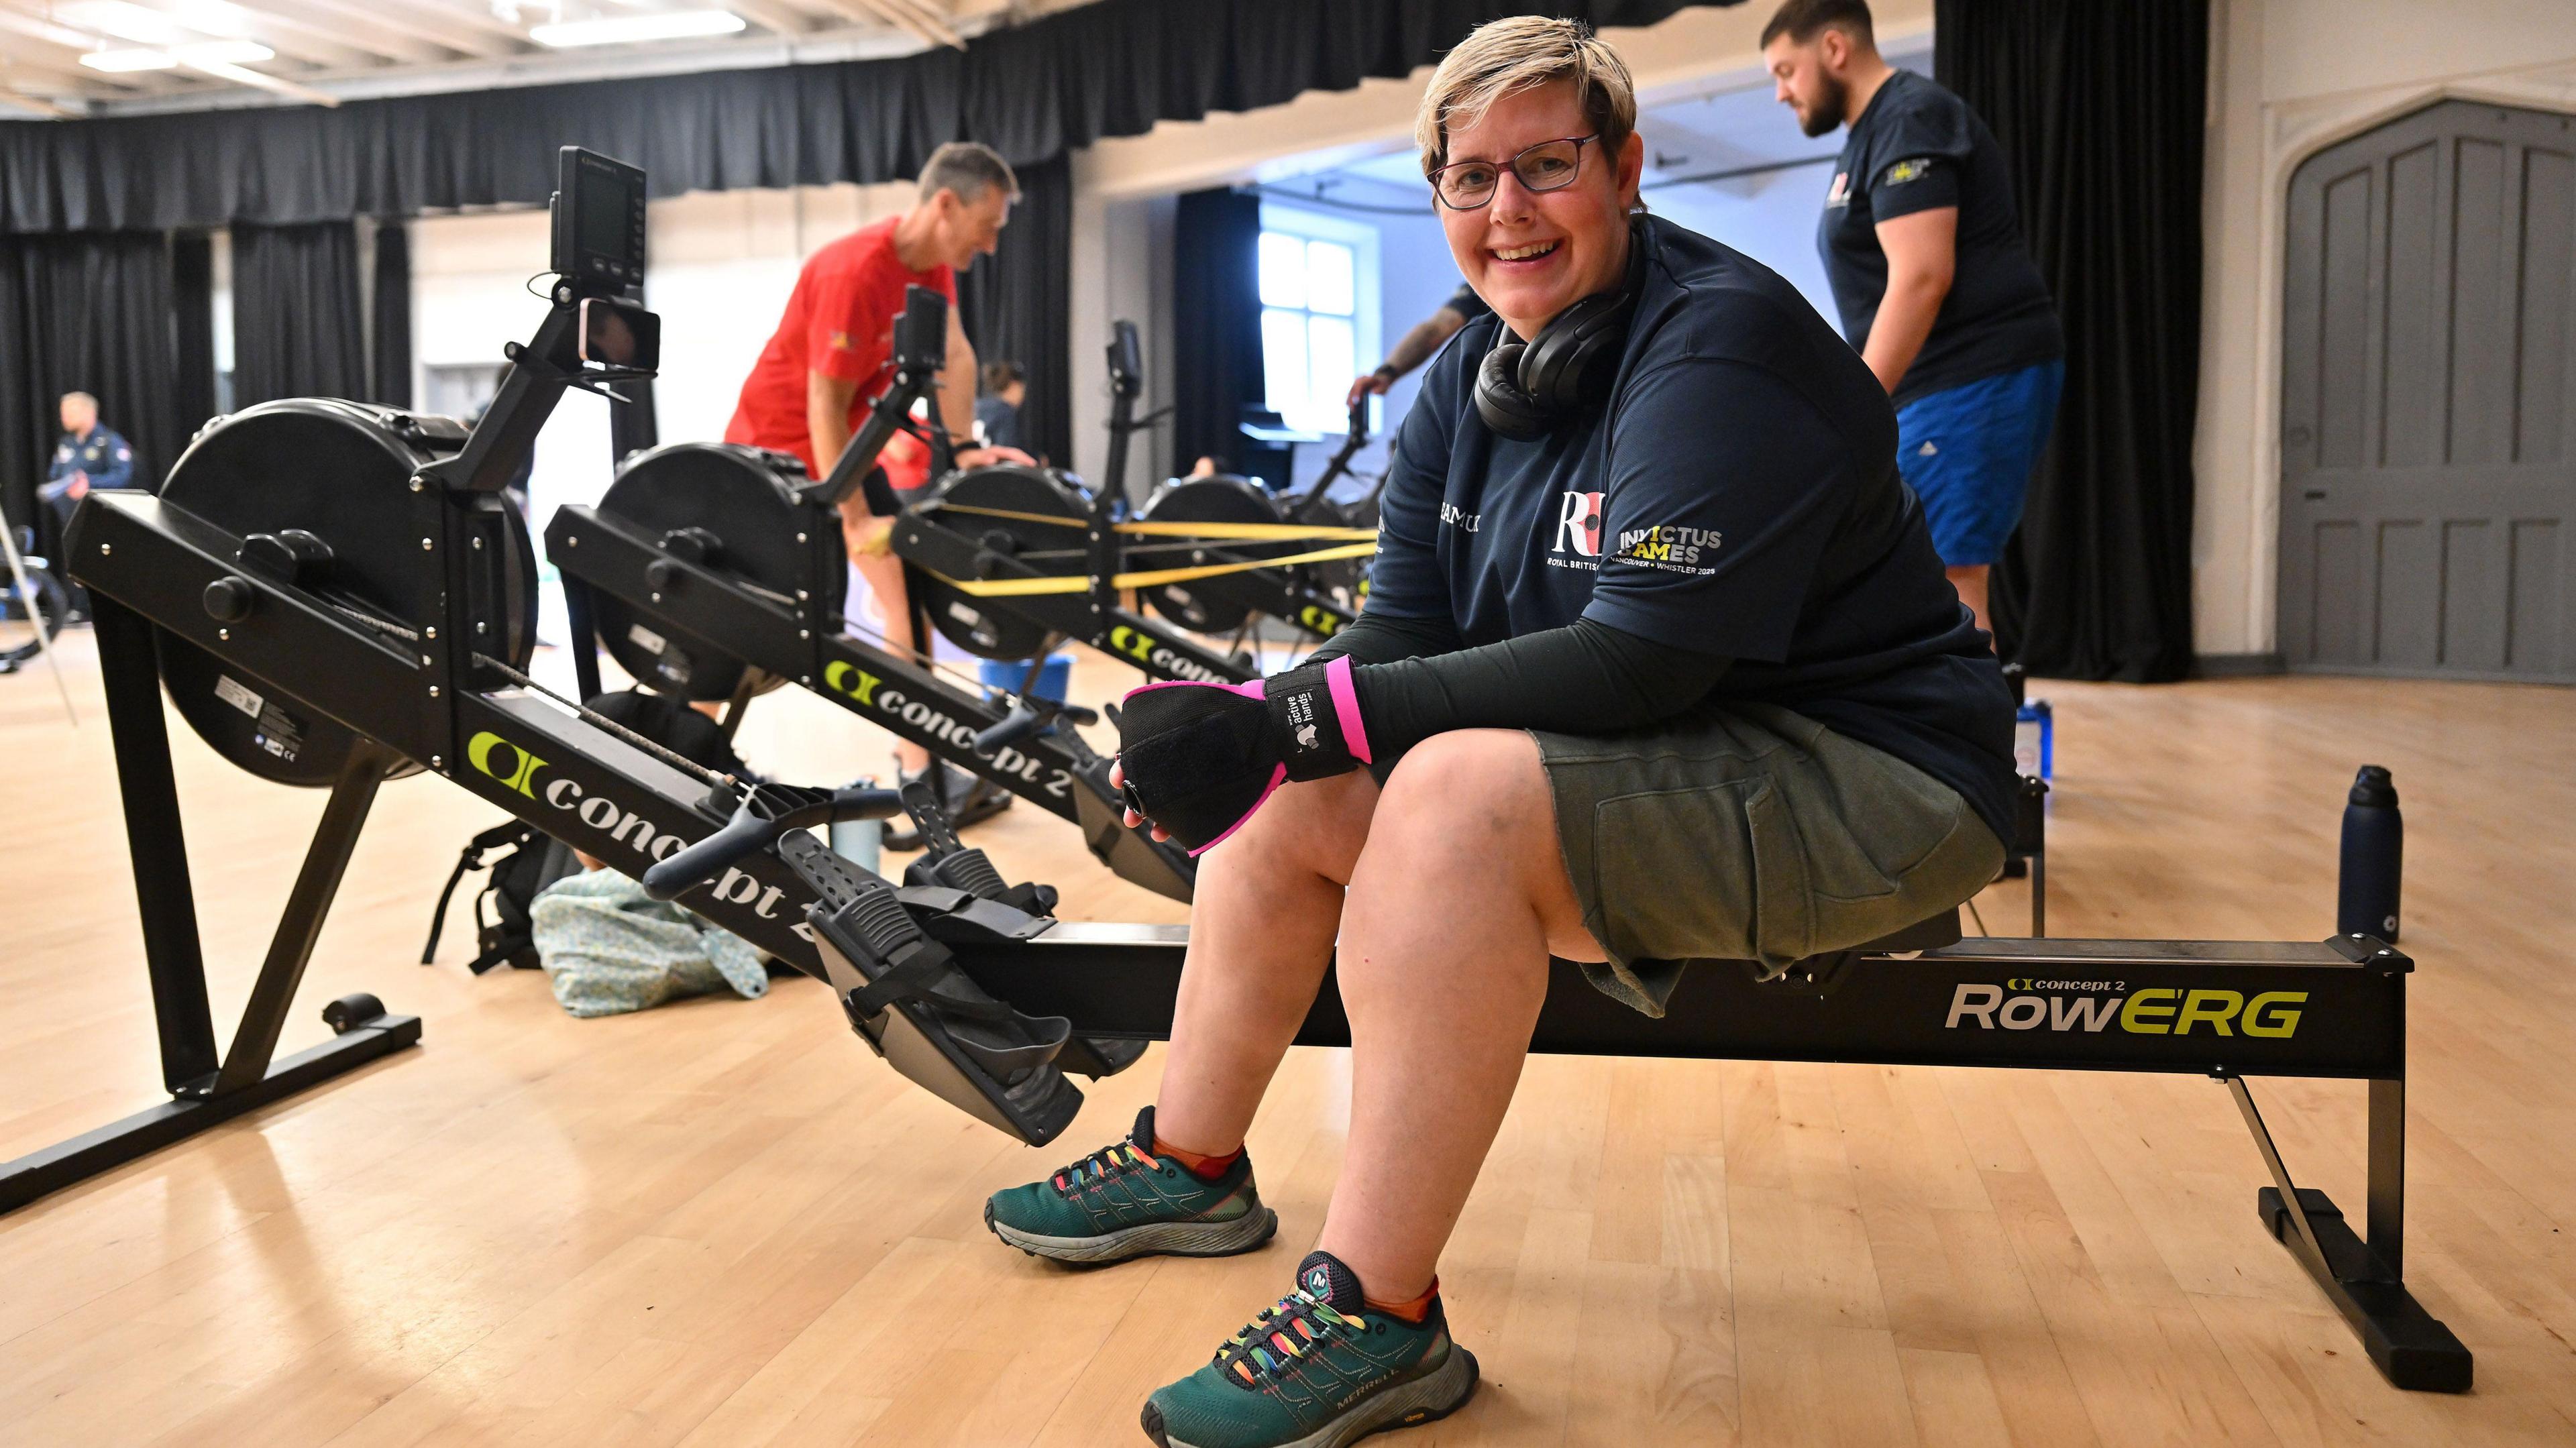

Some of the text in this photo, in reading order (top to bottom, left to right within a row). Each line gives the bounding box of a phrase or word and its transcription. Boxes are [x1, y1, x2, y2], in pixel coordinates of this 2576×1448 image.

[1620, 526, 1723, 549] INVICTUS
[1570, 560, 1599, 571] BRITIS
[1610, 556, 1716, 575] VANCOUVER WHISTLER 2025
[1287, 695, 1302, 724] active
[1297, 693, 1313, 722] hands
[878, 689, 1073, 799] concpt 2
[545, 779, 786, 920] concpt
[2035, 980, 2126, 992] concept 2
